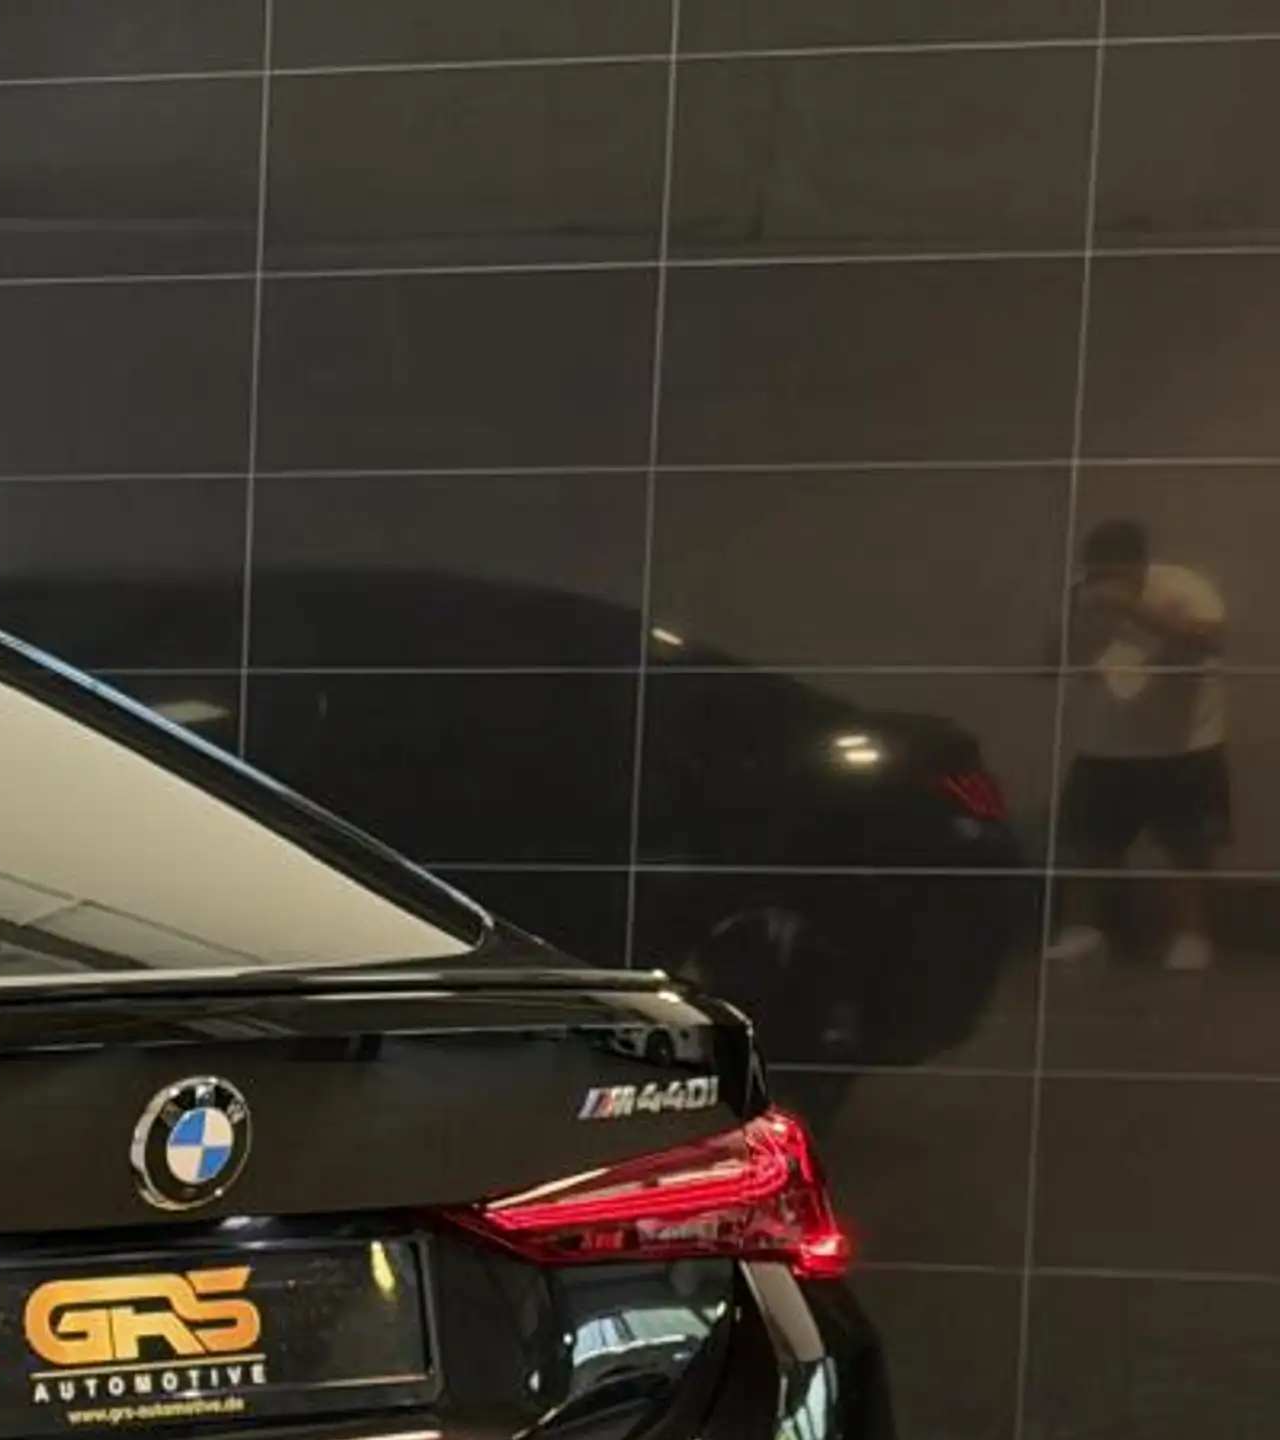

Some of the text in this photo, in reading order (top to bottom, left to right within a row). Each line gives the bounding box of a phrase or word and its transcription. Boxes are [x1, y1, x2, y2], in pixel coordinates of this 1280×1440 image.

[24, 1265, 261, 1365] GRS
[33, 1363, 268, 1403] AUTOMOTIVE
[67, 1396, 245, 1425] www.grs-automotive.de
